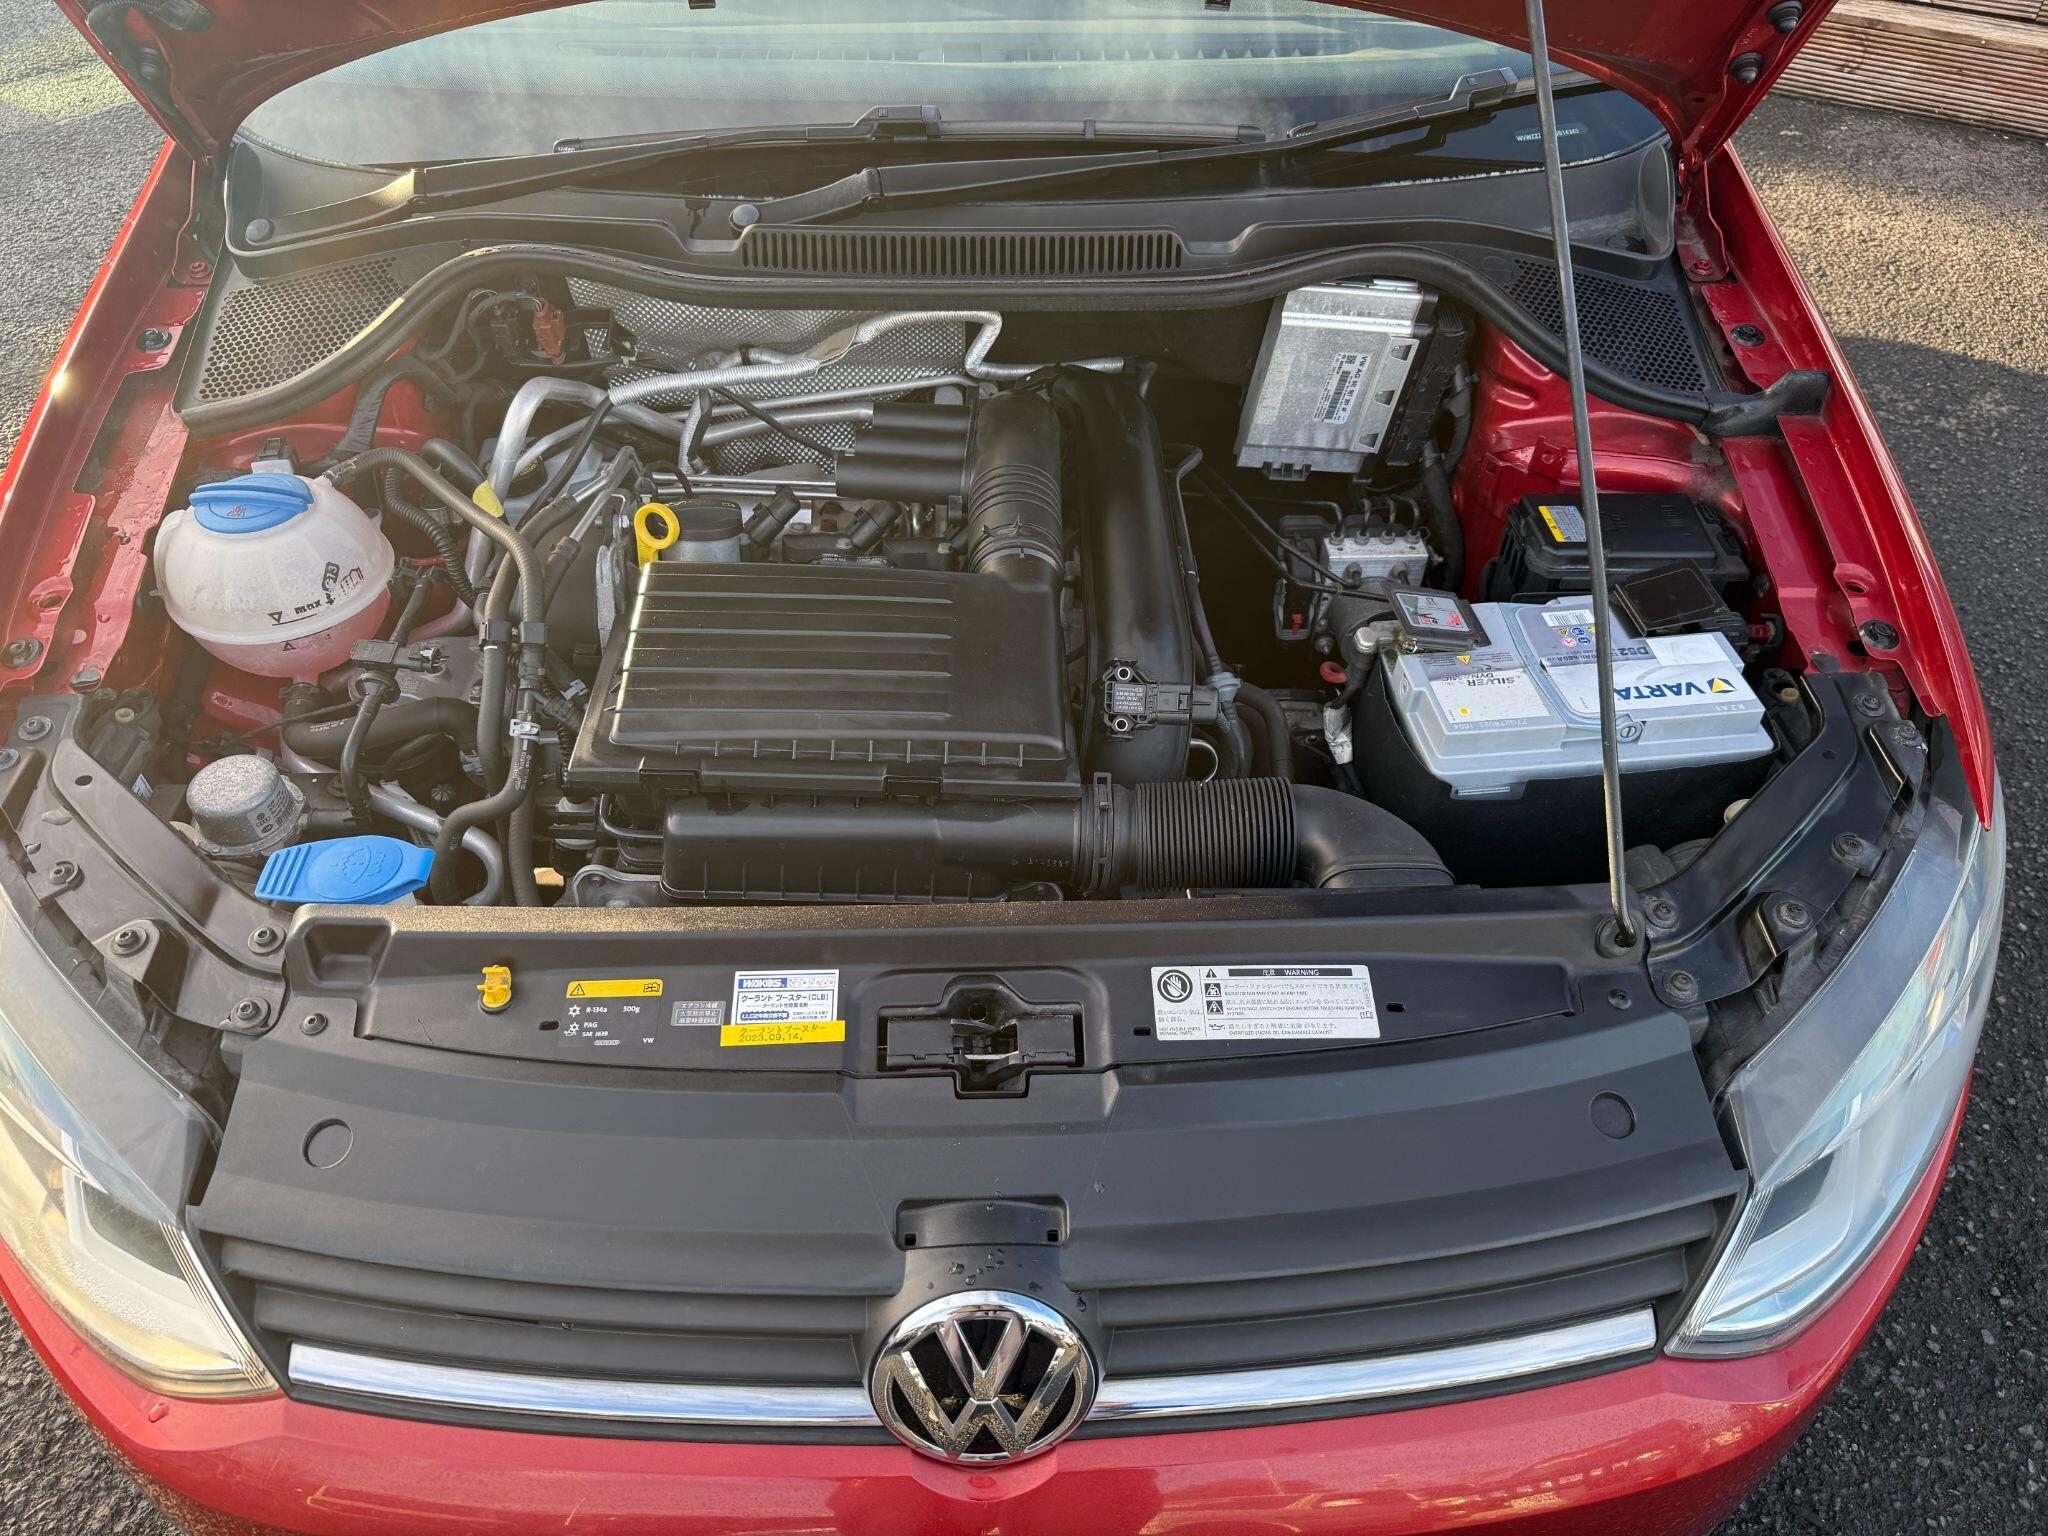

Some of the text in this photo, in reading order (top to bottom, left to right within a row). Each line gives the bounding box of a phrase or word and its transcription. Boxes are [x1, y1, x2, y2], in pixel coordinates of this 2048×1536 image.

[294, 600, 322, 615] max
[1621, 645, 1650, 656] D52
[1467, 676, 1515, 687] SILVER
[1614, 681, 1706, 700] VARTA
[1284, 968, 1320, 976] WARNING
[622, 1005, 640, 1014] 500g
[740, 1023, 828, 1034] クーラントブースター
